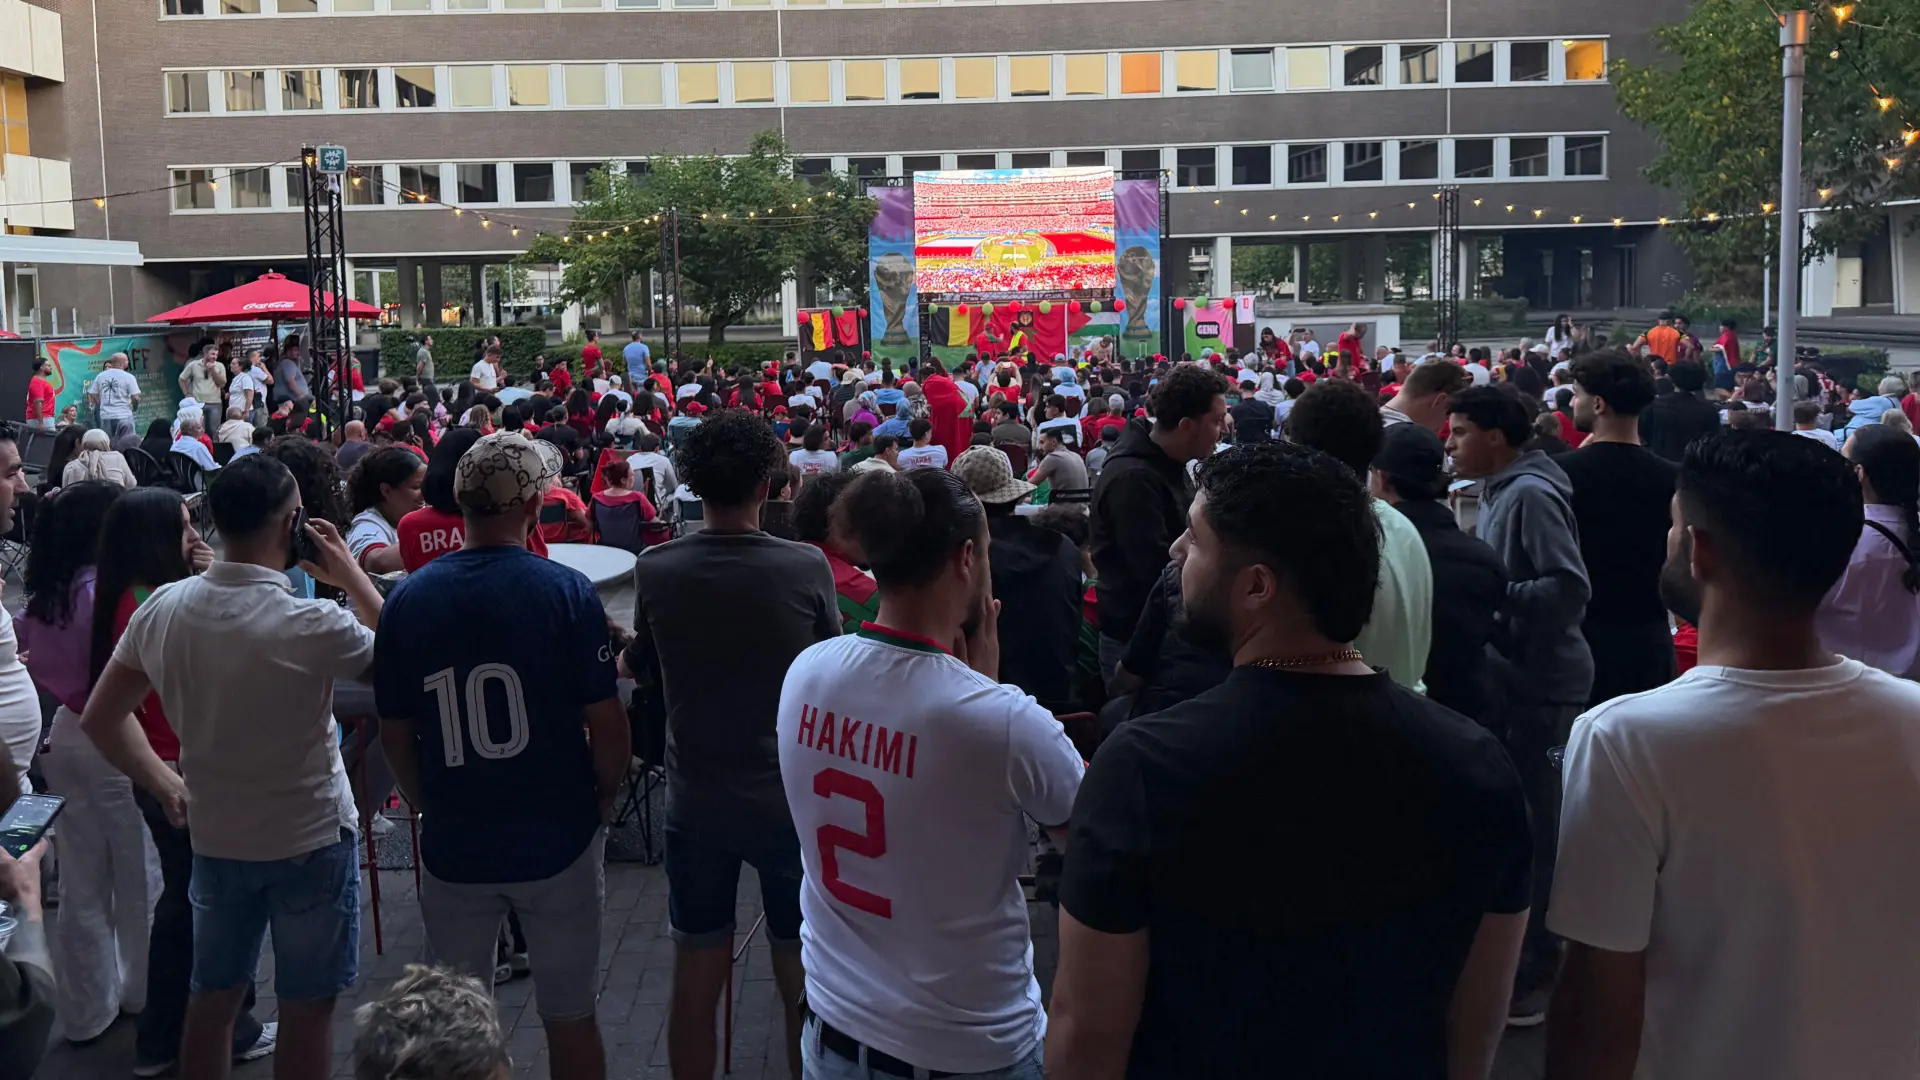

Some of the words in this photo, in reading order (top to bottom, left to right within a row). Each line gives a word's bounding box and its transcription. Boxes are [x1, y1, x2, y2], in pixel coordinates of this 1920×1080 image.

[1197, 325, 1219, 335] GENK
[424, 662, 530, 767] 10
[798, 704, 917, 778] HAKIMI
[813, 767, 892, 919] 2
